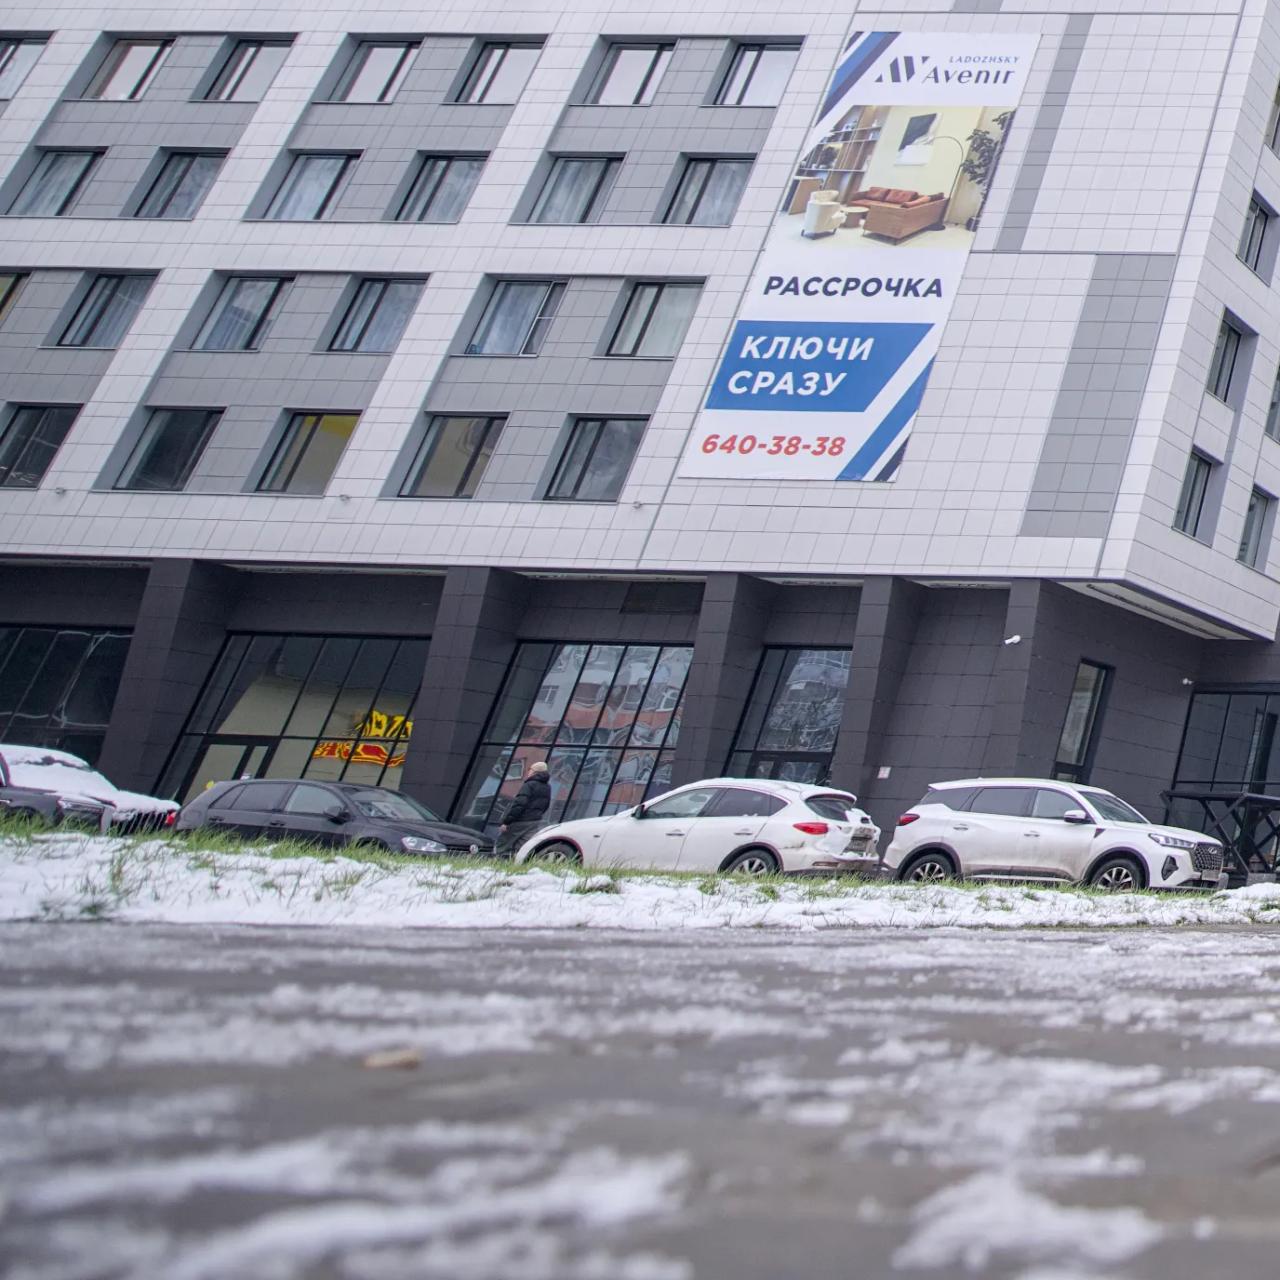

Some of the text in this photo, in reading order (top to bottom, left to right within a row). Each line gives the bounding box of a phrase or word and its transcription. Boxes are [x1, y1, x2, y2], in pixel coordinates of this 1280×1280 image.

[950, 55, 1019, 64] LADOZHSKY
[763, 276, 943, 298] РАССРОЧКА
[739, 336, 875, 361] КЛЮЧИ
[727, 371, 848, 396] СРАЗУ
[702, 434, 847, 457] 640-38-38
